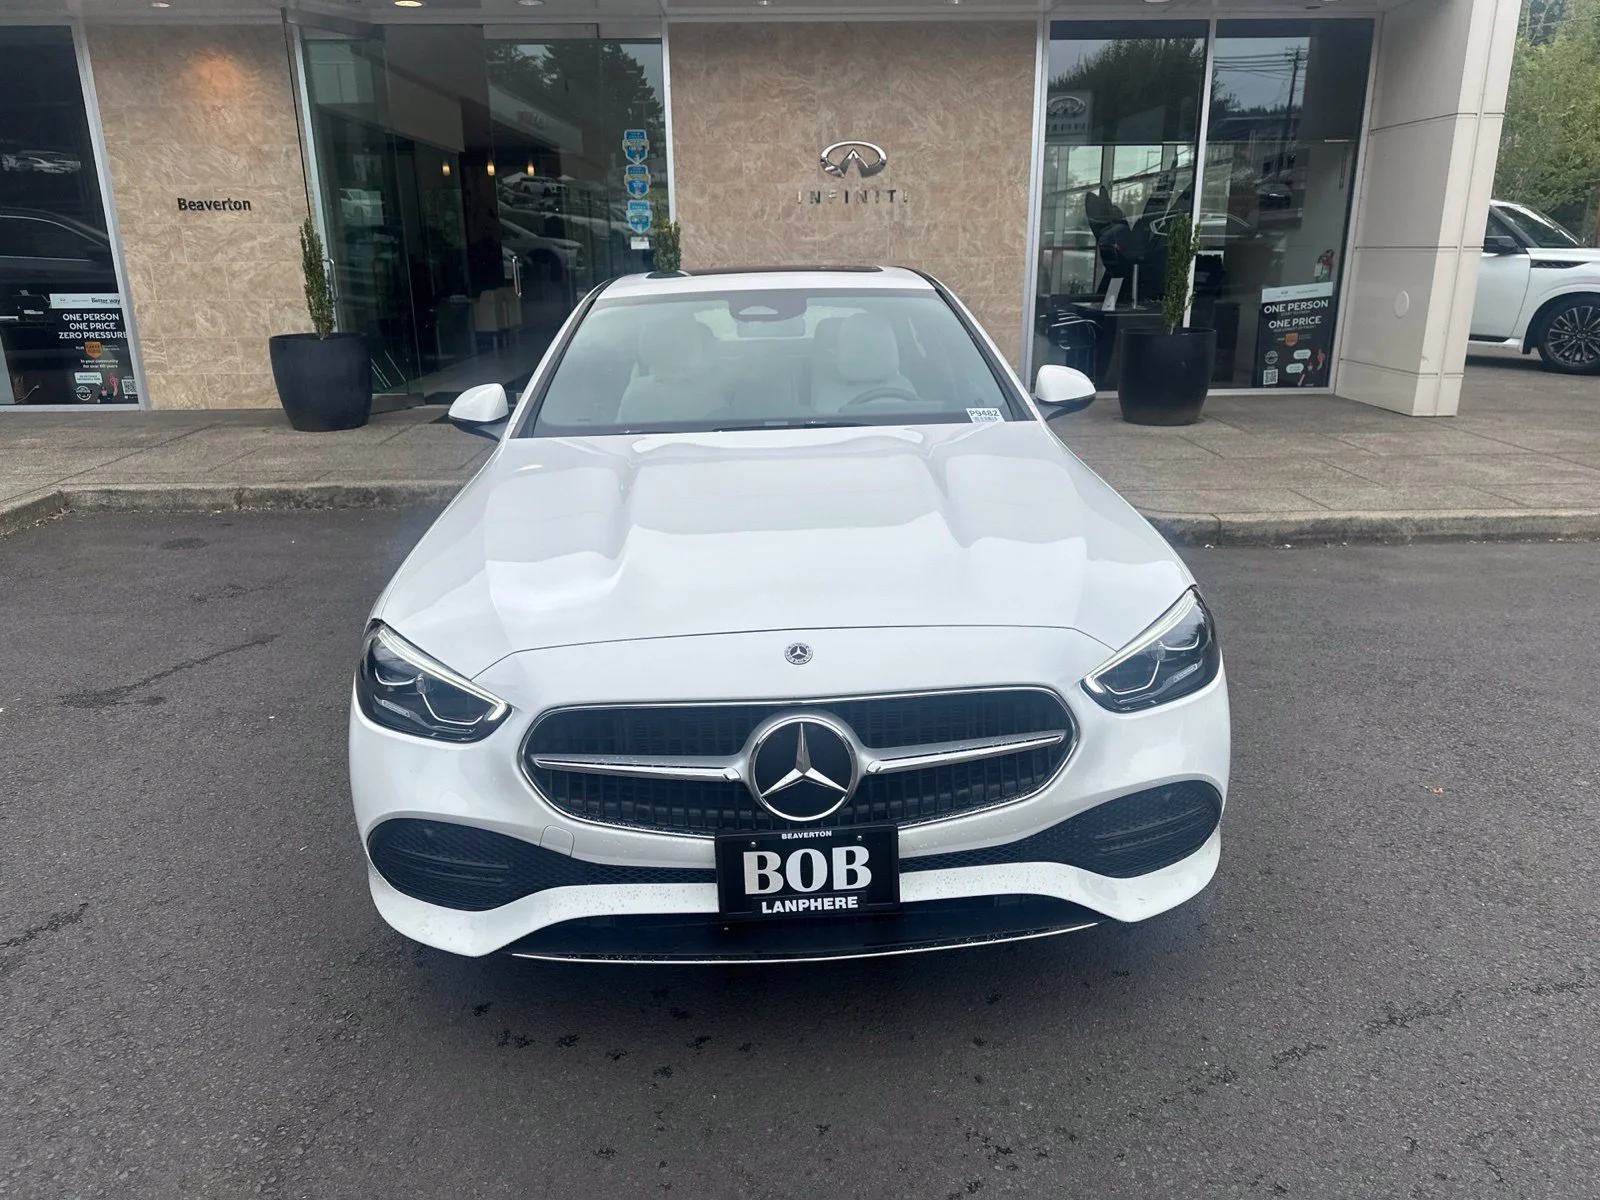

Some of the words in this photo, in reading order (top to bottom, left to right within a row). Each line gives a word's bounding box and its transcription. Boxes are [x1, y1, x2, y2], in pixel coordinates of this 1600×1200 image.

[797, 189, 908, 204] INFINITI
[177, 197, 252, 211] Beaverton
[1263, 303, 1286, 314] ONE
[1287, 299, 1329, 311] PERSON
[62, 313, 81, 321] ONE
[83, 313, 119, 321] PERSON
[1268, 318, 1291, 329] ONE
[1292, 315, 1322, 327] PRICE
[69, 322, 88, 330] ONE
[89, 322, 116, 330] PRICE
[58, 331, 82, 339] ZERO
[969, 409, 999, 417] P9482
[781, 830, 832, 840] BEAVERTON
[743, 845, 872, 895] BOB
[761, 896, 859, 914] LANPHERE
